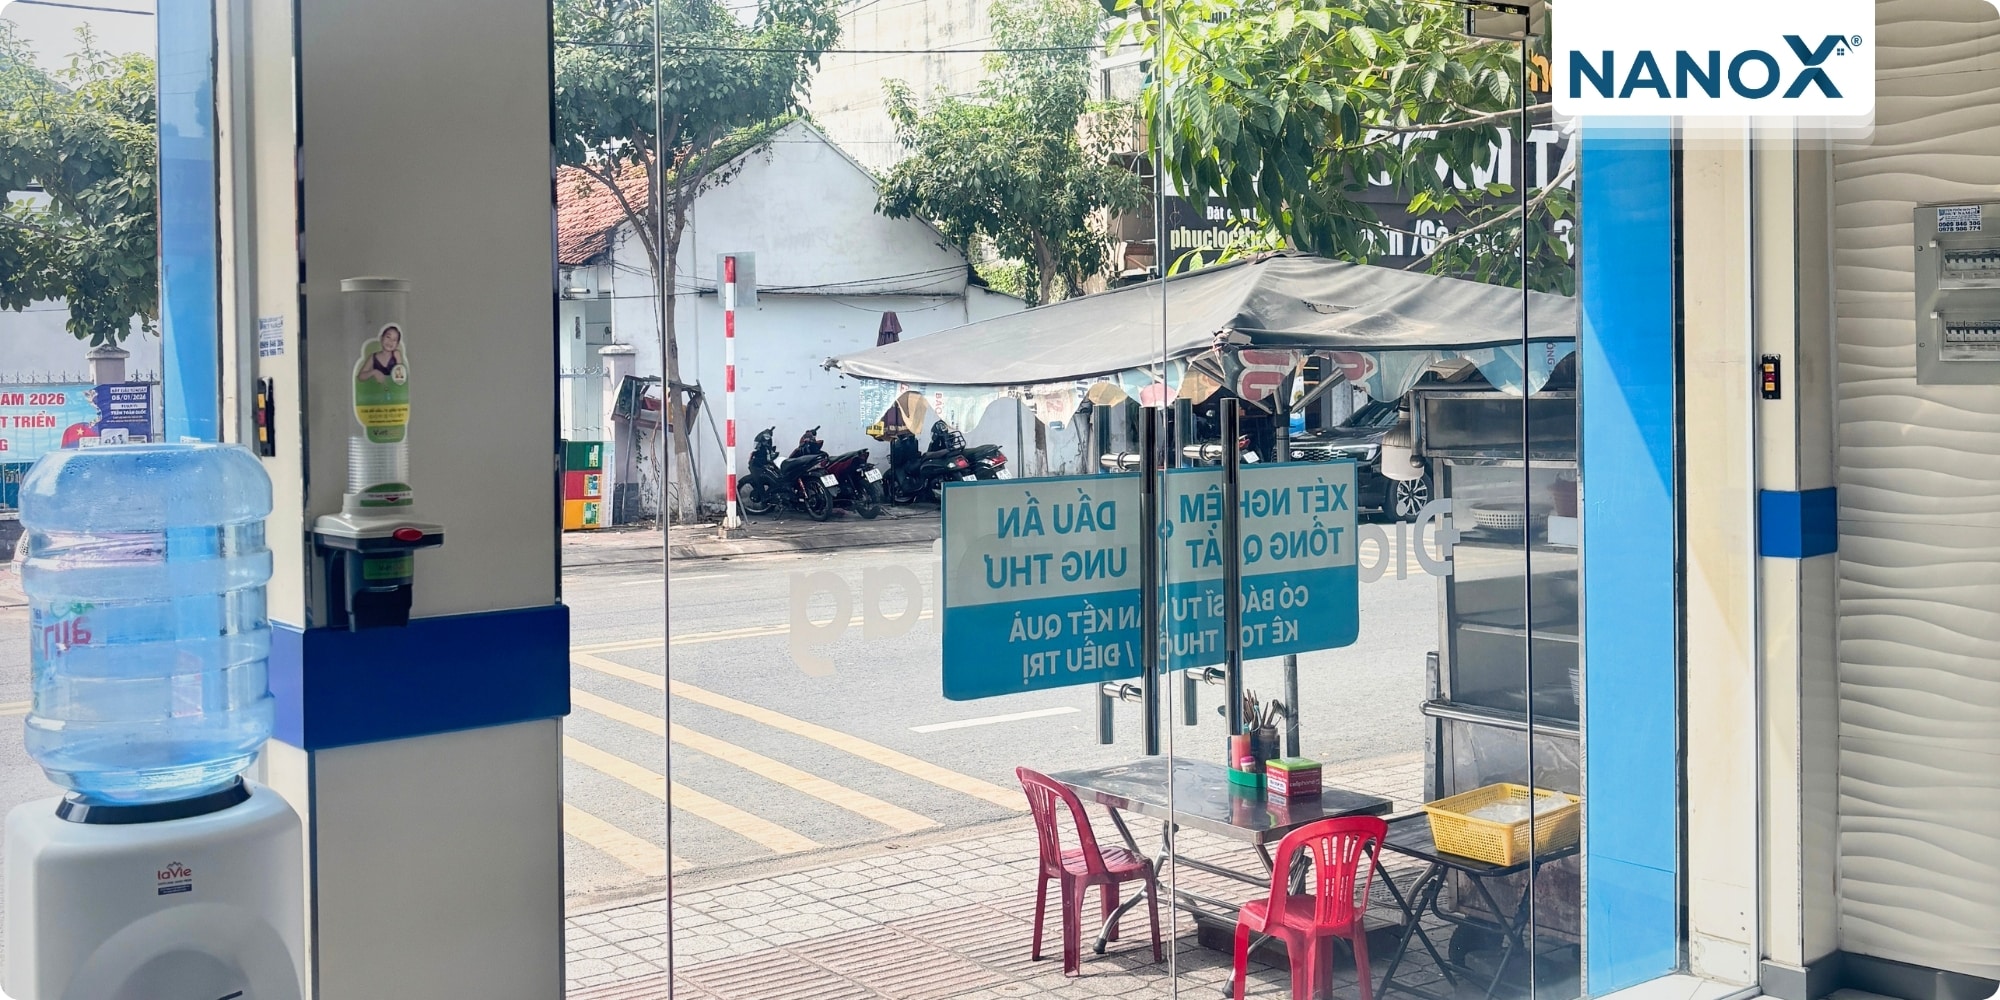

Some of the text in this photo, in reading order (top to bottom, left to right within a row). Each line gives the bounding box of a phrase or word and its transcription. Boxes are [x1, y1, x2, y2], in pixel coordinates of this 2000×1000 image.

[1227, 207, 1250, 220] cm
[30, 393, 65, 405] 2026
[13, 411, 56, 428] TRIỂN
